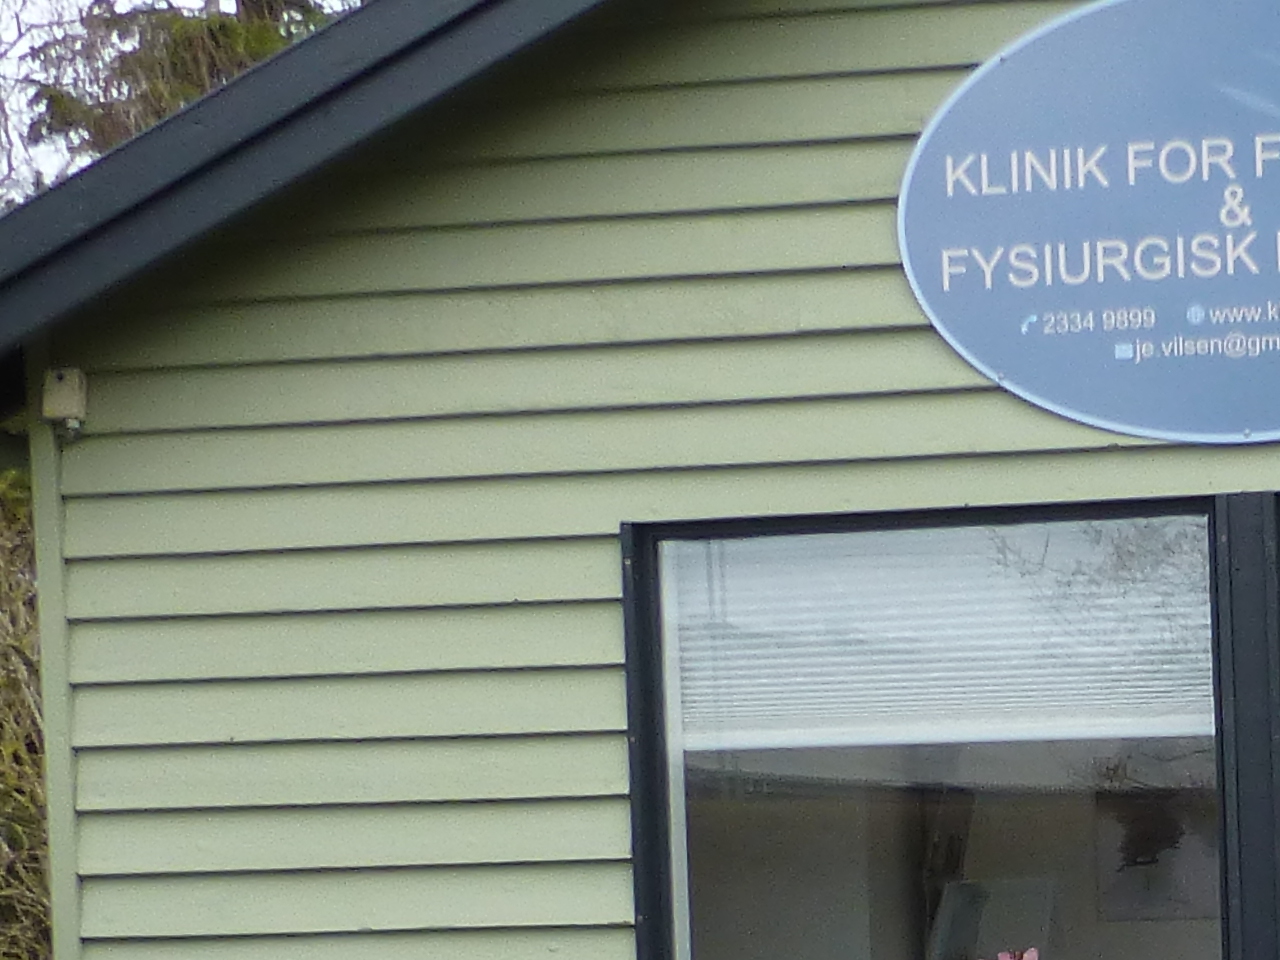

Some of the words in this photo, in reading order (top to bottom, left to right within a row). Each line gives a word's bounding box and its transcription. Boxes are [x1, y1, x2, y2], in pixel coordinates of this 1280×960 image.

[945, 146, 1109, 197] KLINIK
[1126, 138, 1235, 186] FOR
[1219, 184, 1253, 229] &
[940, 233, 1259, 292] FYSIURGISK
[1042, 311, 1094, 335] 2334
[1102, 308, 1156, 332] 9899
